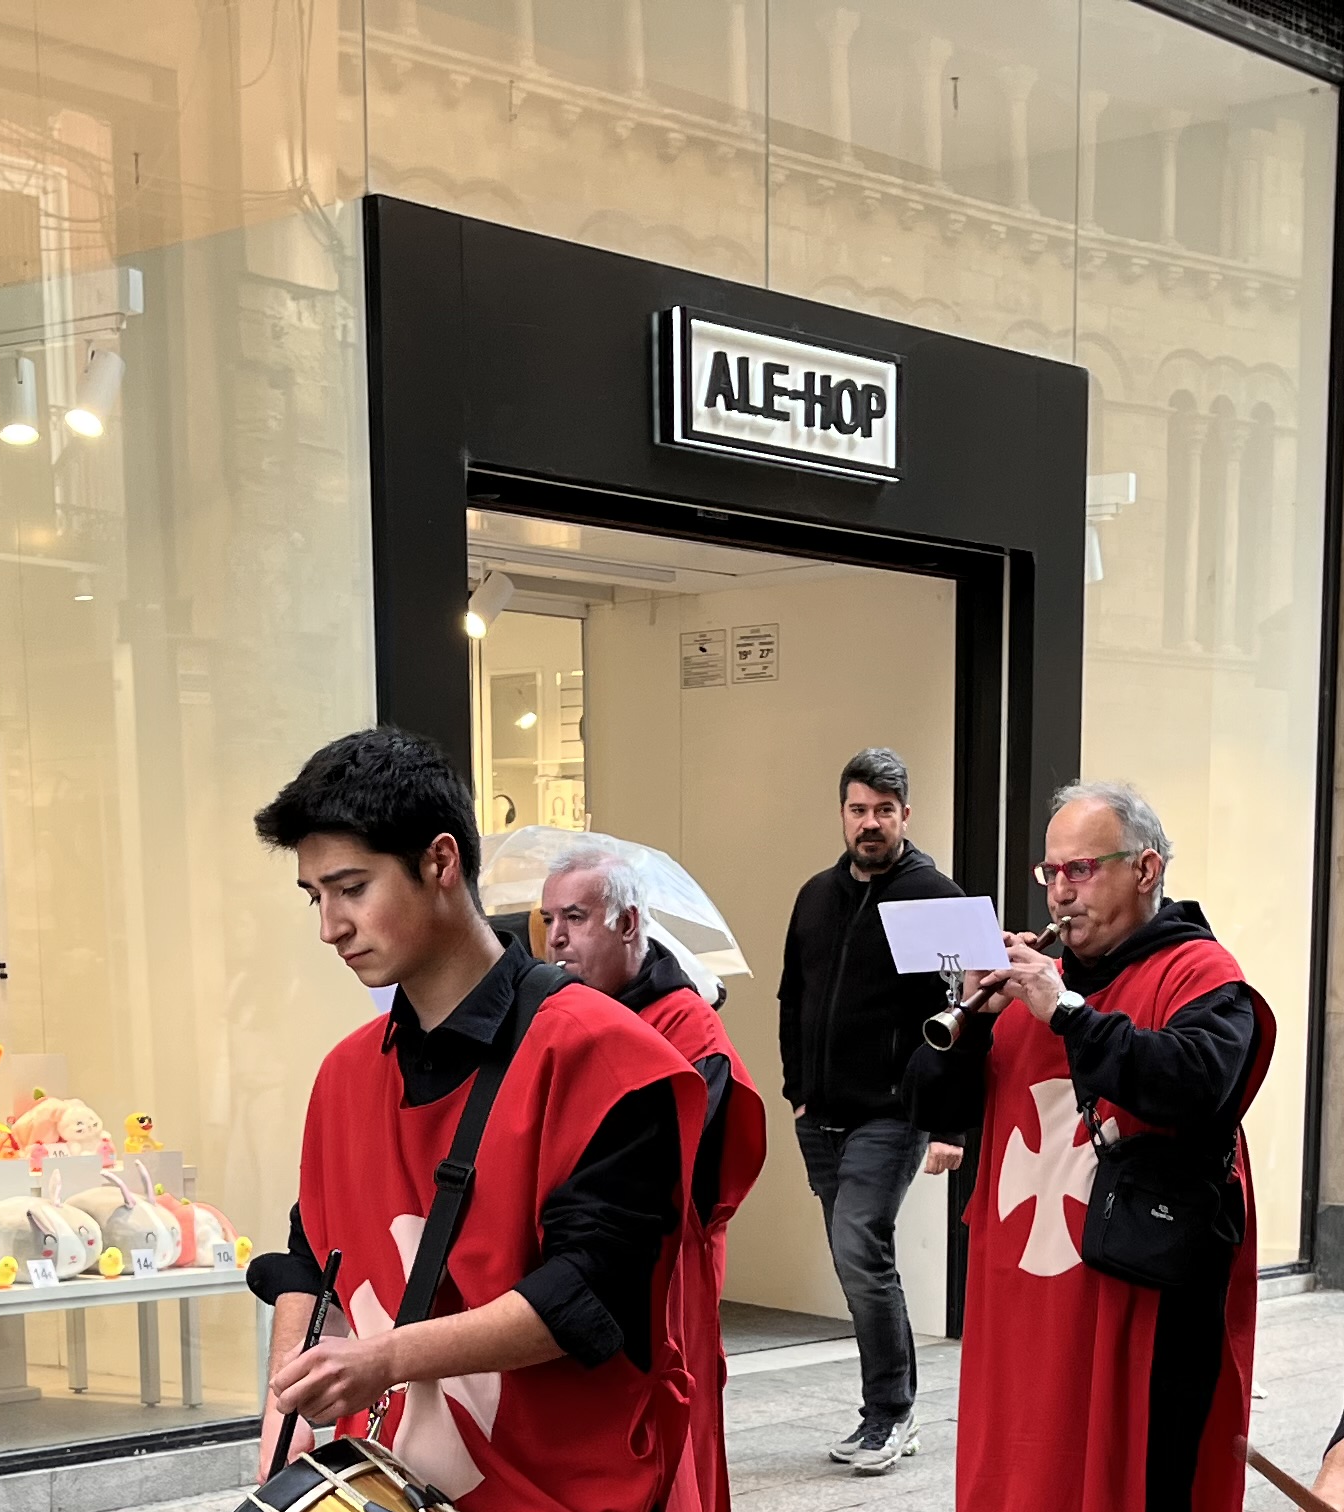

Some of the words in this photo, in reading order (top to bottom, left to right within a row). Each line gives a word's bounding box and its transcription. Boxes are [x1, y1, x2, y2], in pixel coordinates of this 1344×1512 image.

[704, 351, 886, 438] ALE-HOP
[137, 1257, 153, 1270] 14€
[216, 1251, 233, 1263] 10€
[34, 1267, 53, 1280] 14€
